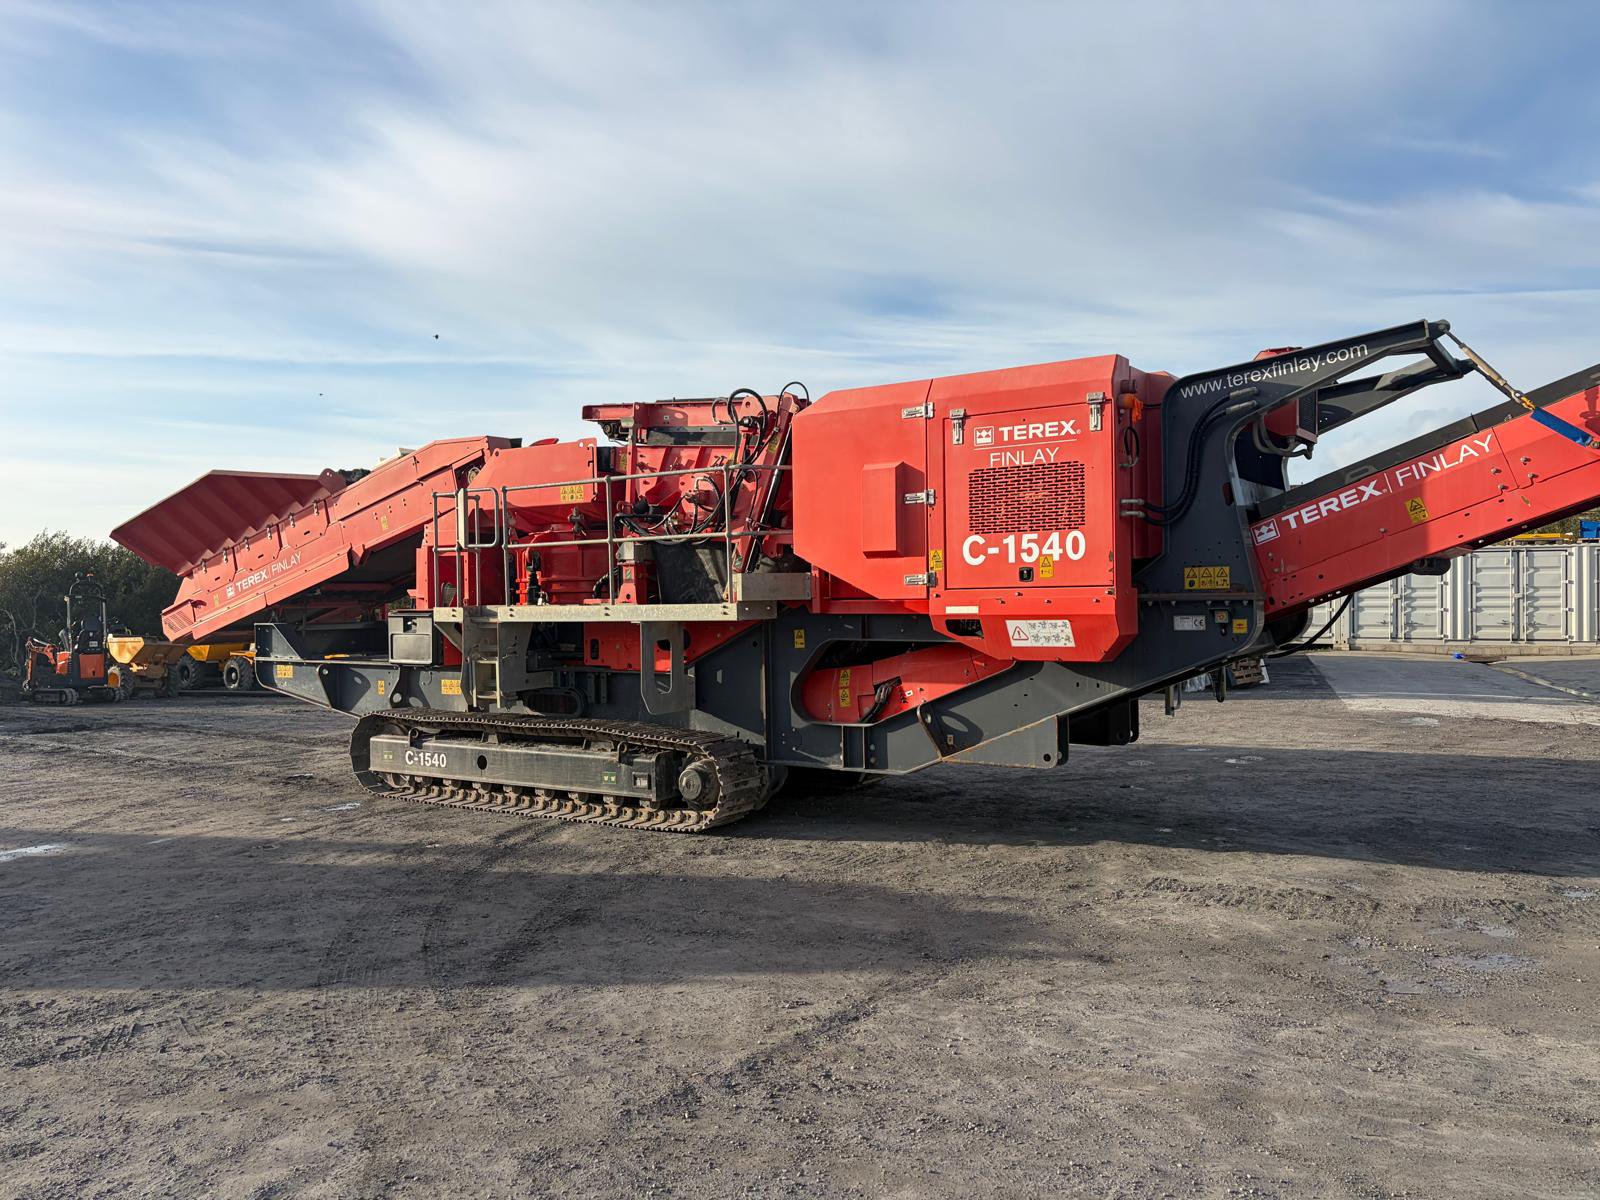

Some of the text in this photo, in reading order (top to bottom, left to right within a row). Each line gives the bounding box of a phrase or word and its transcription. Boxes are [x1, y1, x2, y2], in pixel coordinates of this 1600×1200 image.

[1180, 343, 1369, 399] www.terexfinlay.com
[999, 419, 1076, 442] TEREX
[990, 447, 1059, 468] FINLAY
[1282, 434, 1493, 529] TEREX FINLAY
[962, 530, 1086, 566] C-1540
[236, 551, 302, 592] TEREX FINLAY
[405, 750, 447, 768] C-1540
